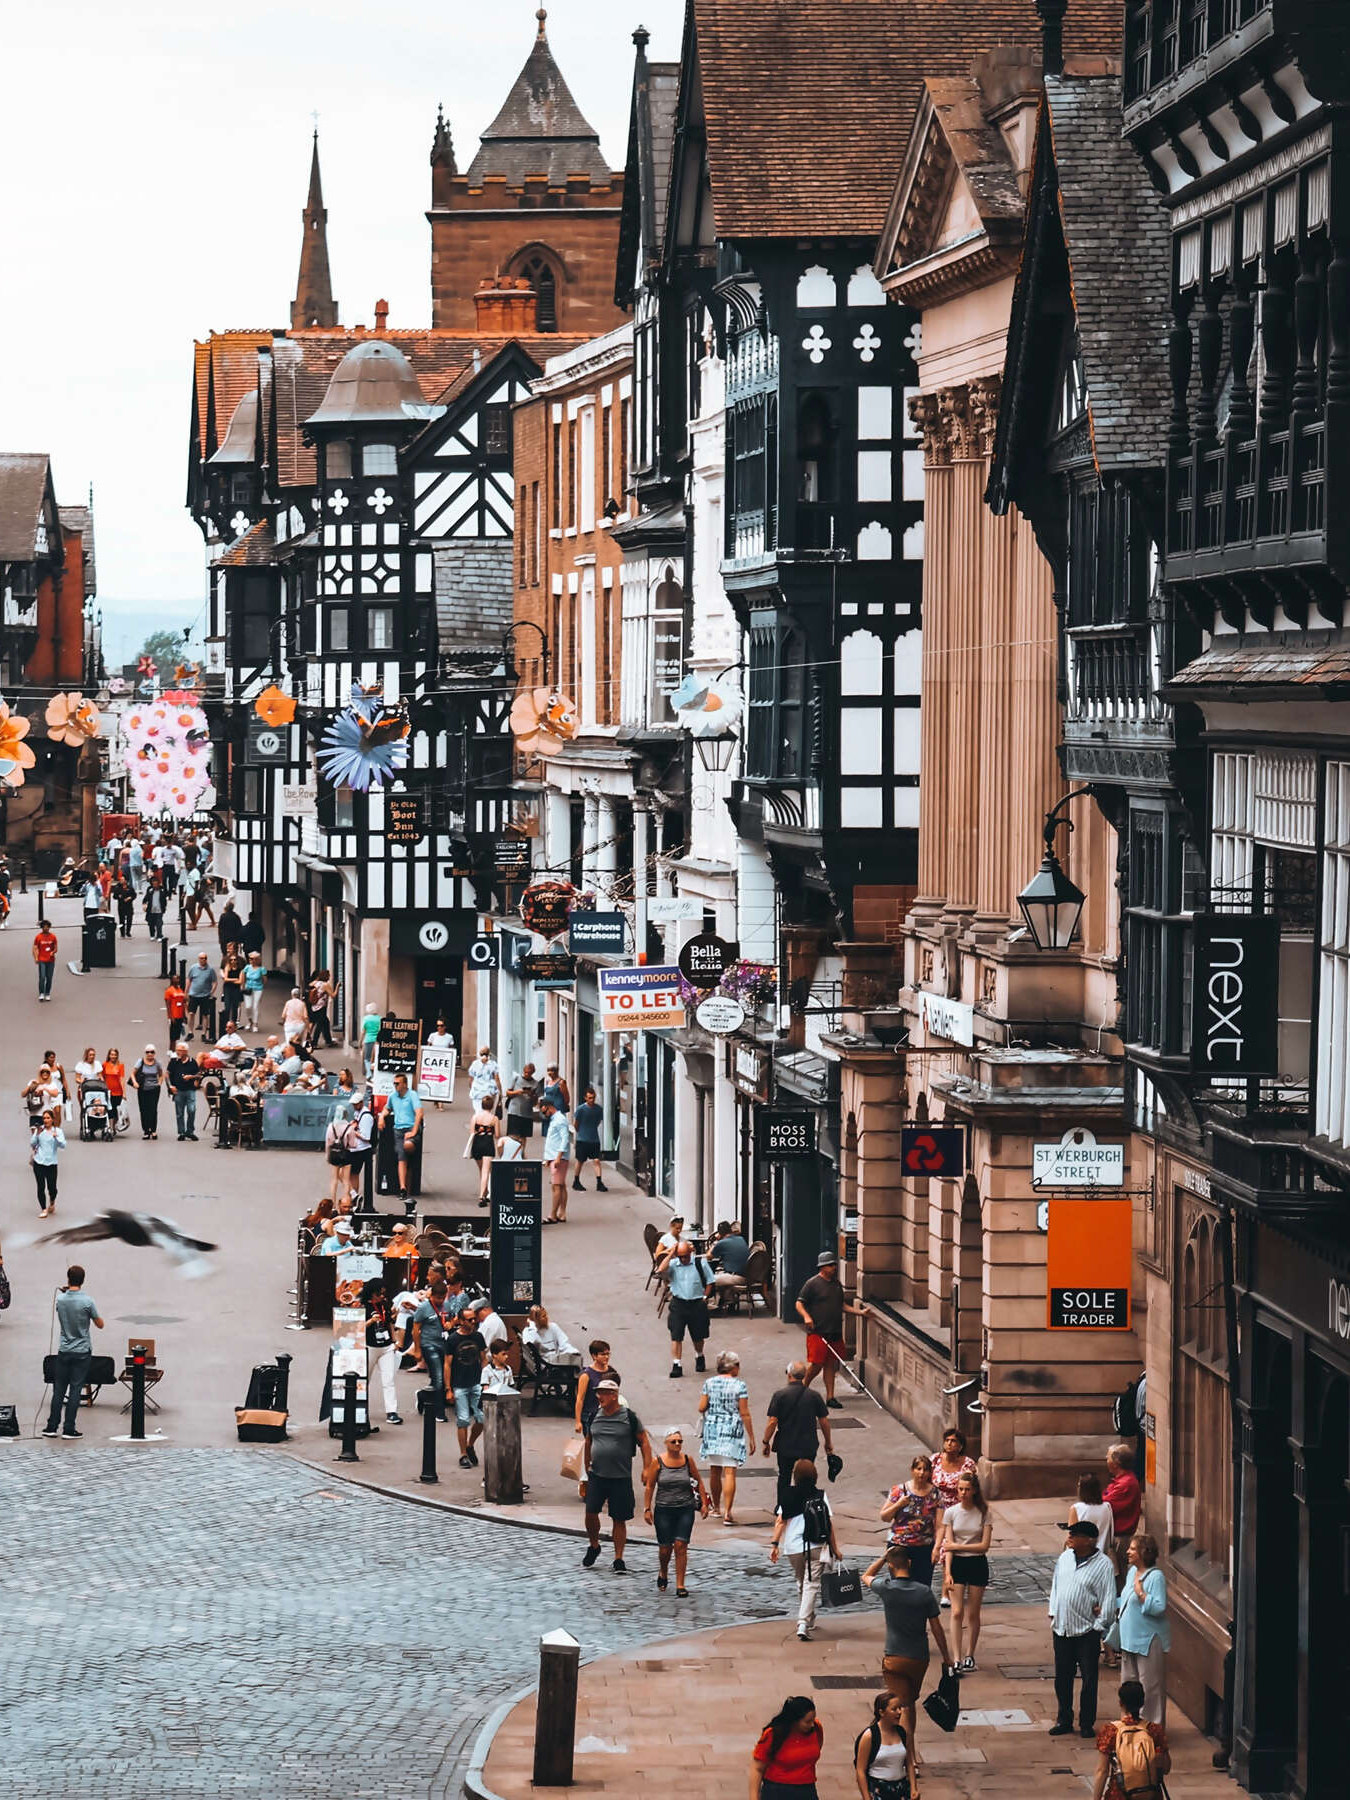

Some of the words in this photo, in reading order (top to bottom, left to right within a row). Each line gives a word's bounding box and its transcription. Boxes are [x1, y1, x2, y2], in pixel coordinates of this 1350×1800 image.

[391, 811, 416, 820] Boot
[577, 923, 621, 933] Carphone
[573, 932, 621, 940] Warehouse
[690, 945, 721, 957] Bella
[605, 972, 677, 986] kenneymoore
[606, 994, 633, 1009] TO
[641, 992, 679, 1008] LET
[1207, 938, 1244, 1061] next
[394, 1022, 418, 1030] LEATHER
[391, 1031, 408, 1039] SHOP
[424, 1057, 450, 1068] CAFE
[287, 1114, 332, 1127] NER
[770, 1125, 806, 1135] MOSS
[770, 1136, 809, 1147] BROS.
[1036, 1150, 1052, 1161] ST.
[1055, 1150, 1121, 1162] WERBURGH
[1055, 1167, 1101, 1178] STREET
[499, 1204, 513, 1213] The
[498, 1213, 534, 1226] Rows
[1062, 1292, 1115, 1308] SOLE
[1328, 1278, 1350, 1340] ne
[1062, 1314, 1114, 1325] TRADER
